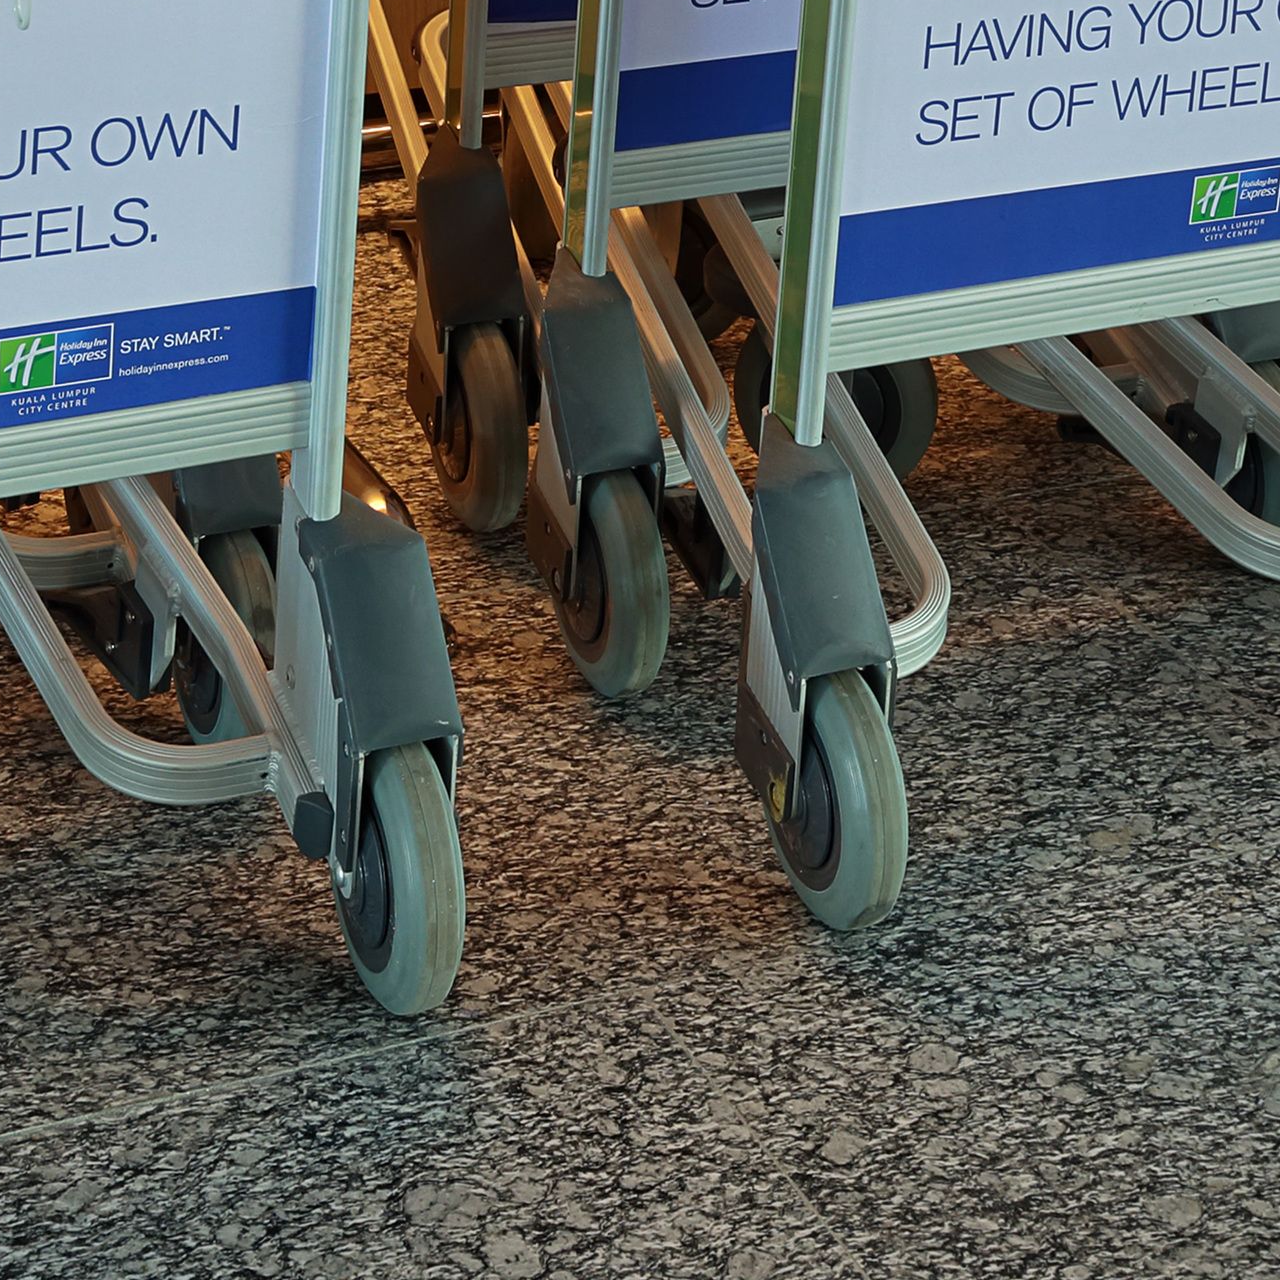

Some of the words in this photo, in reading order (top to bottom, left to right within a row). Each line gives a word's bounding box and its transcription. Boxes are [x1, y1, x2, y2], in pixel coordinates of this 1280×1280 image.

[924, 6, 1112, 69] HAVING
[916, 92, 1015, 145] SET
[1028, 82, 1098, 131] OF
[91, 104, 240, 167] OWN
[60, 340, 93, 351] Holiday
[93, 337, 108, 348] Inn
[120, 336, 159, 354] STAY
[59, 349, 107, 366] Express
[119, 354, 229, 376] holidayinnexpress.com
[11, 395, 46, 406] KUALA
[52, 387, 95, 400] LUMPUR
[18, 405, 42, 415] CITY
[47, 398, 87, 411] CENTRE
